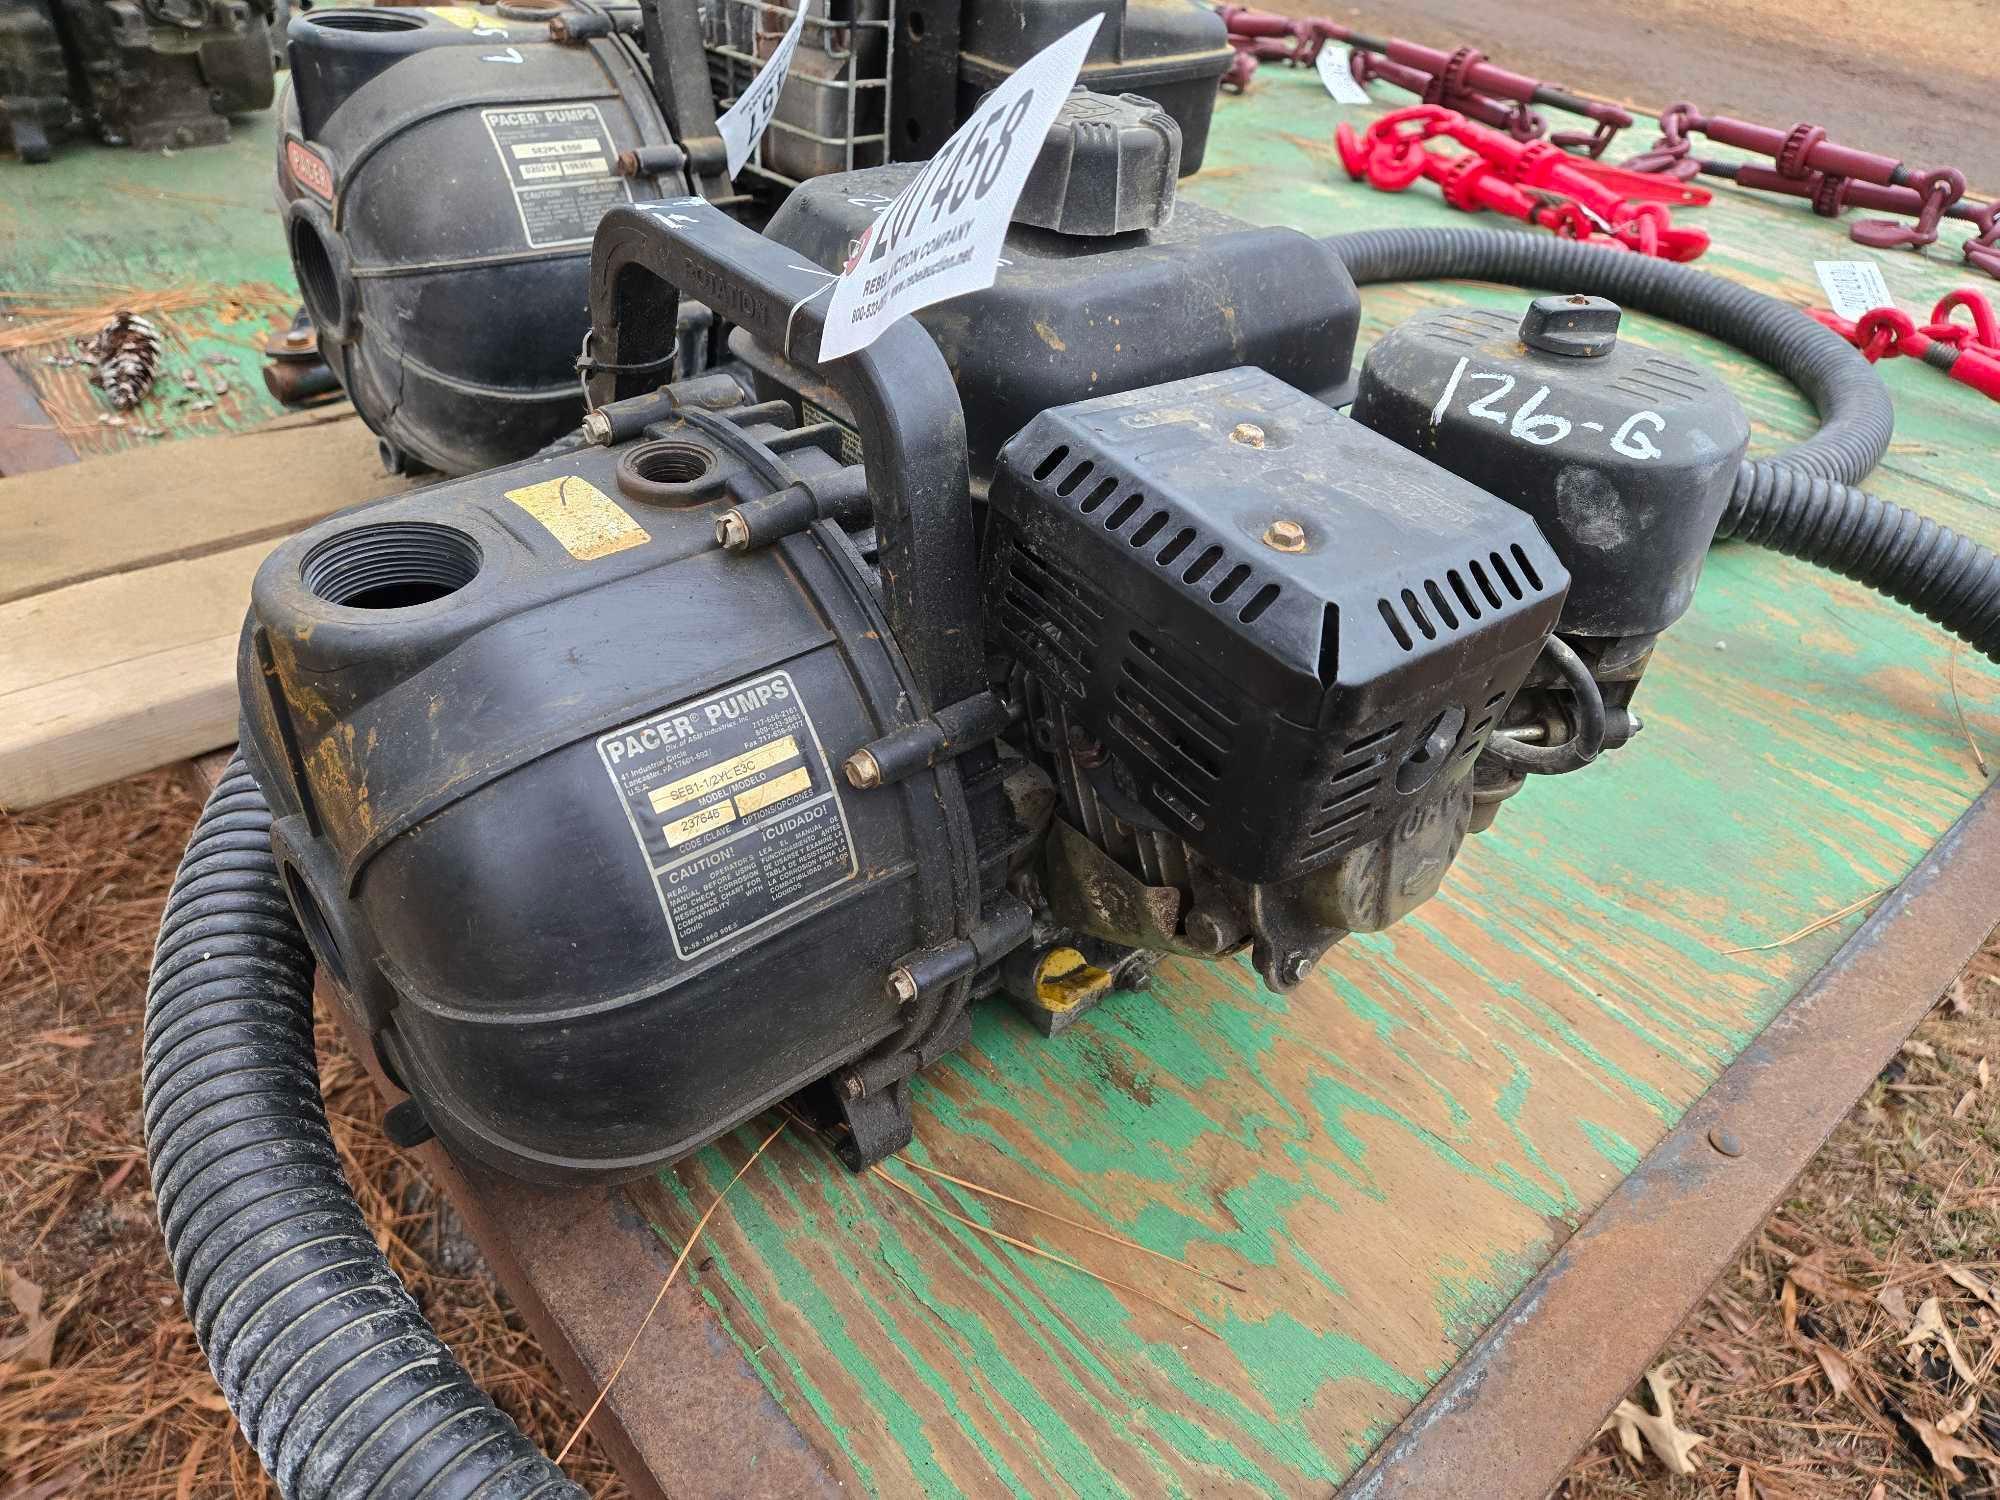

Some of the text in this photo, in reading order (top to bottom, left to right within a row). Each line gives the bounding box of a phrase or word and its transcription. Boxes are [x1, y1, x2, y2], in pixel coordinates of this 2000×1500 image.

[489, 108, 596, 127] PACER PUMPS
[920, 217, 975, 260] COMPANY
[1430, 356, 1666, 459] 126-G
[705, 680, 788, 725] PUMPS
[744, 740, 757, 749] Fax
[631, 759, 665, 777] Industrial
[666, 751, 687, 762] Circle
[663, 764, 672, 773] PA
[733, 761, 755, 776] E3C
[698, 773, 766, 806] MODEL/MODELO
[742, 789, 813, 825] OPTIONS/OPCIONES
[758, 846, 772, 856] LEA
[795, 824, 822, 839] MANUAL
[829, 816, 838, 824] DE
[762, 805, 826, 841] ¡CUIDADO!
[821, 823, 840, 836] ANTES
[669, 847, 734, 883] CAUTION!
[763, 862, 772, 871] DE
[774, 850, 799, 866] USARSE
[834, 830, 843, 838] LA
[766, 865, 786, 878] TABLA
[788, 860, 797, 868] DE
[799, 841, 838, 863] RESISTENCIA
[768, 878, 777, 886] LA
[819, 850, 836, 861] PARA
[824, 859, 833, 867] DE
[836, 852, 848, 862] LOS
[667, 885, 688, 899] READ
[670, 862, 756, 907] MANUAL BEFORE USING
[673, 870, 758, 915] AND CHECK CORROSION
[675, 877, 761, 922] RESISTANCE CHART FOR
[772, 883, 801, 901] LIQUIDOS
[677, 885, 763, 929] COMPATIBILITY WITH
[679, 923, 703, 938] LIQUID
